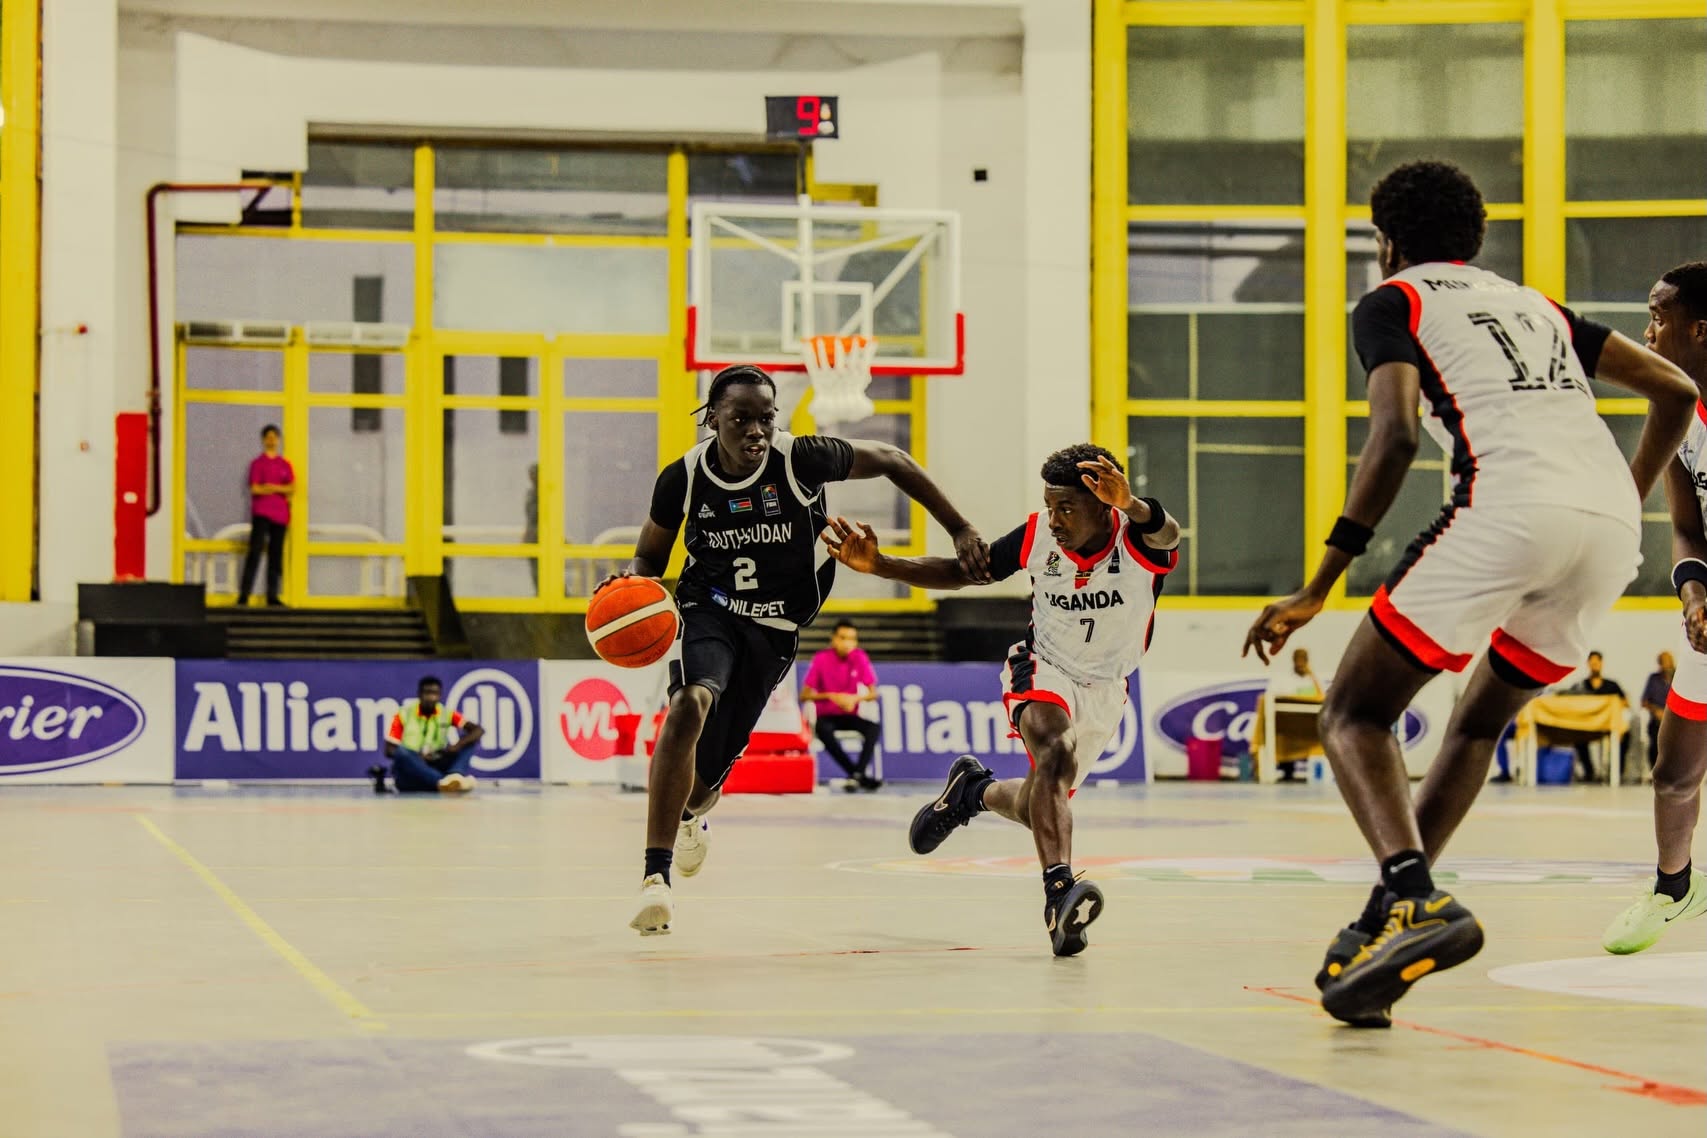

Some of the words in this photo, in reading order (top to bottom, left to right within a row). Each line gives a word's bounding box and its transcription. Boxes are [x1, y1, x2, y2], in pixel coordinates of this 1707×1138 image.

[796, 96, 820, 136] 9
[732, 557, 759, 591] 2
[728, 599, 785, 617] NILEPET
[1080, 618, 1095, 643] 7
[183, 681, 421, 752] Allian
